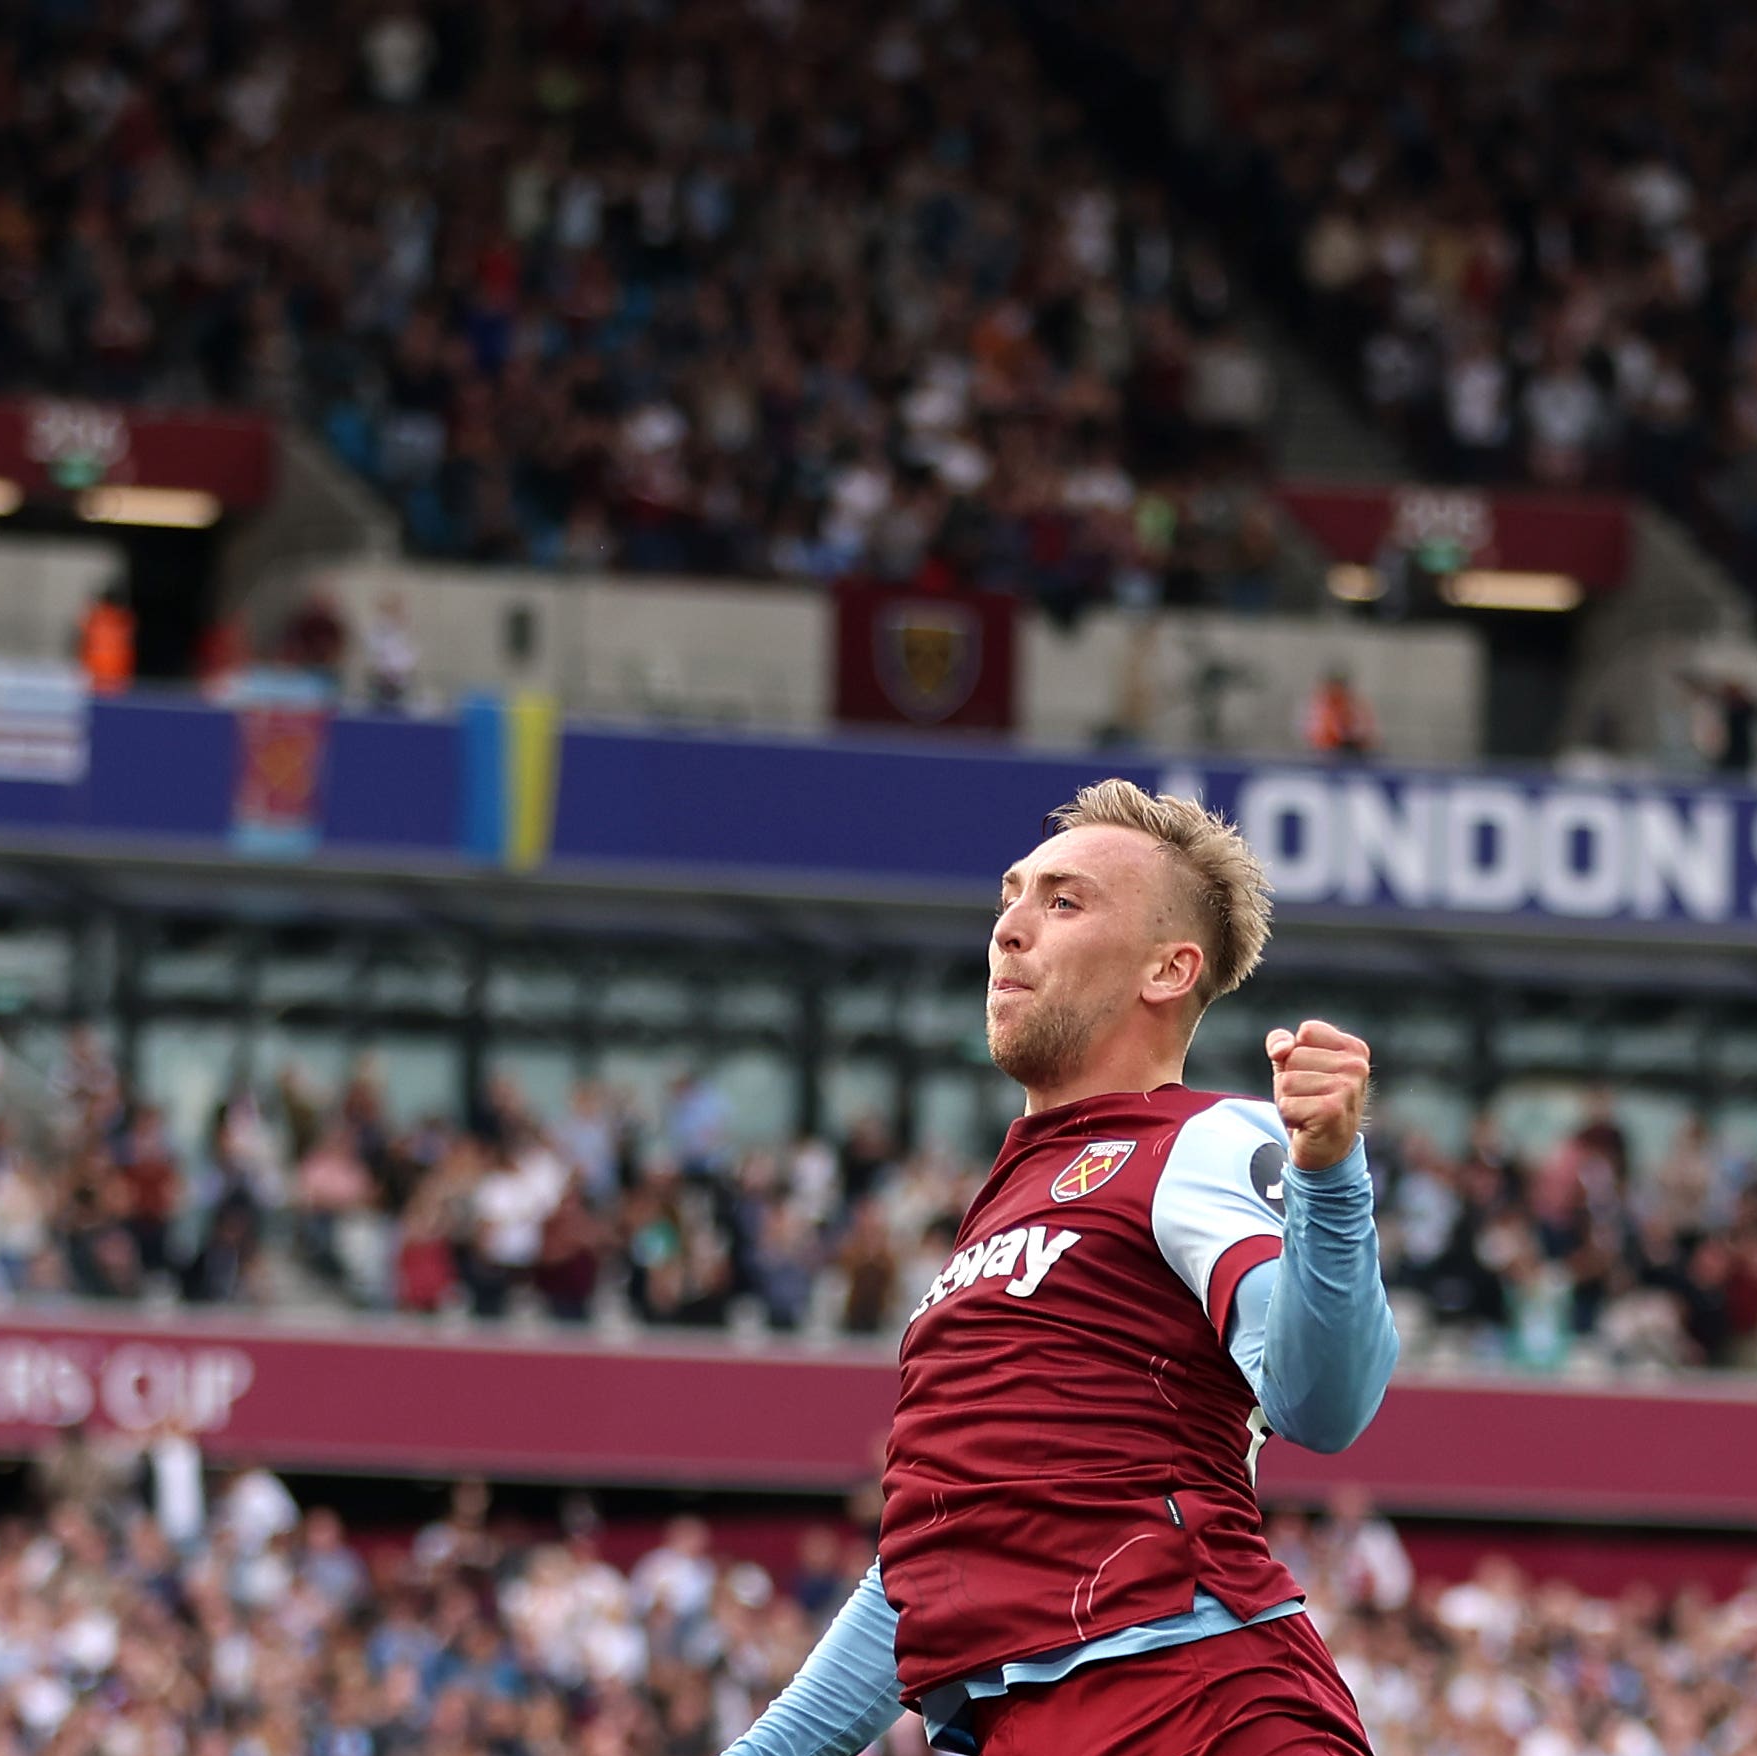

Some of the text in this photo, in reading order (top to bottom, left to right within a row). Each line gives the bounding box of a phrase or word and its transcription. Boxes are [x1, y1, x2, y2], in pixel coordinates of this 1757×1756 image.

[1162, 764, 1740, 926] ONDON
[909, 1226, 1082, 1323] etway
[100, 1342, 254, 1432] CUP
